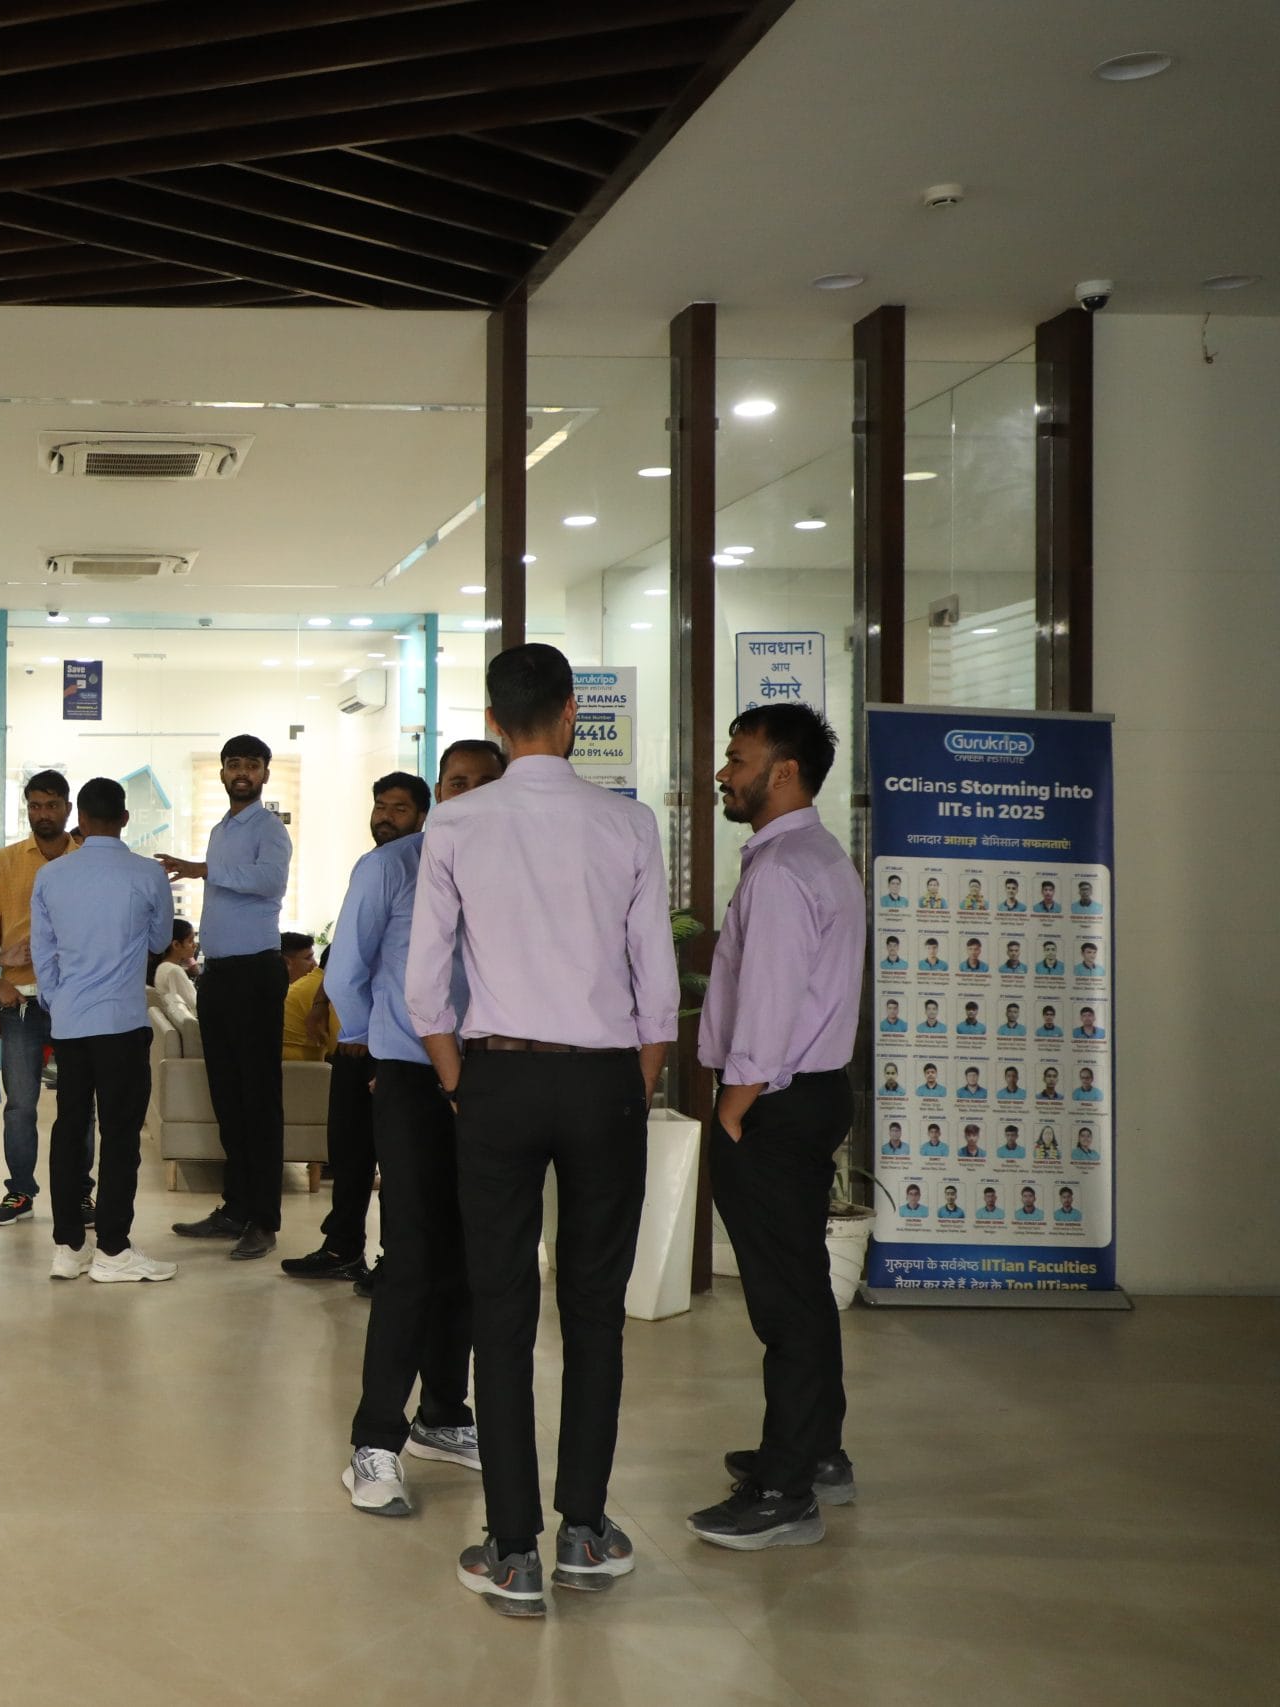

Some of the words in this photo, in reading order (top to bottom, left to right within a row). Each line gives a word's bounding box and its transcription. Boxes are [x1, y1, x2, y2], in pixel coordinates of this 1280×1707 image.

[67, 664, 86, 673] Save
[771, 663, 790, 672] आप
[760, 676, 801, 699] कैमरे
[587, 694, 627, 703] MANAS
[951, 734, 1028, 754] Gurukripa
[587, 748, 602, 757] 891
[603, 748, 624, 757] 4416
[986, 755, 1025, 764] INSTITUTE
[885, 776, 958, 794] GCIians
[960, 779, 1051, 801] Storming
[1053, 782, 1094, 799] into
[938, 801, 972, 818] IITs
[975, 802, 995, 819] in
[998, 803, 1046, 821] 2025
[907, 834, 942, 845] शानदार
[885, 1258, 925, 1273] गुरुकृपा
[927, 1256, 938, 1269] के
[982, 1258, 1024, 1273] IITian
[1028, 1260, 1097, 1275] Faculties
